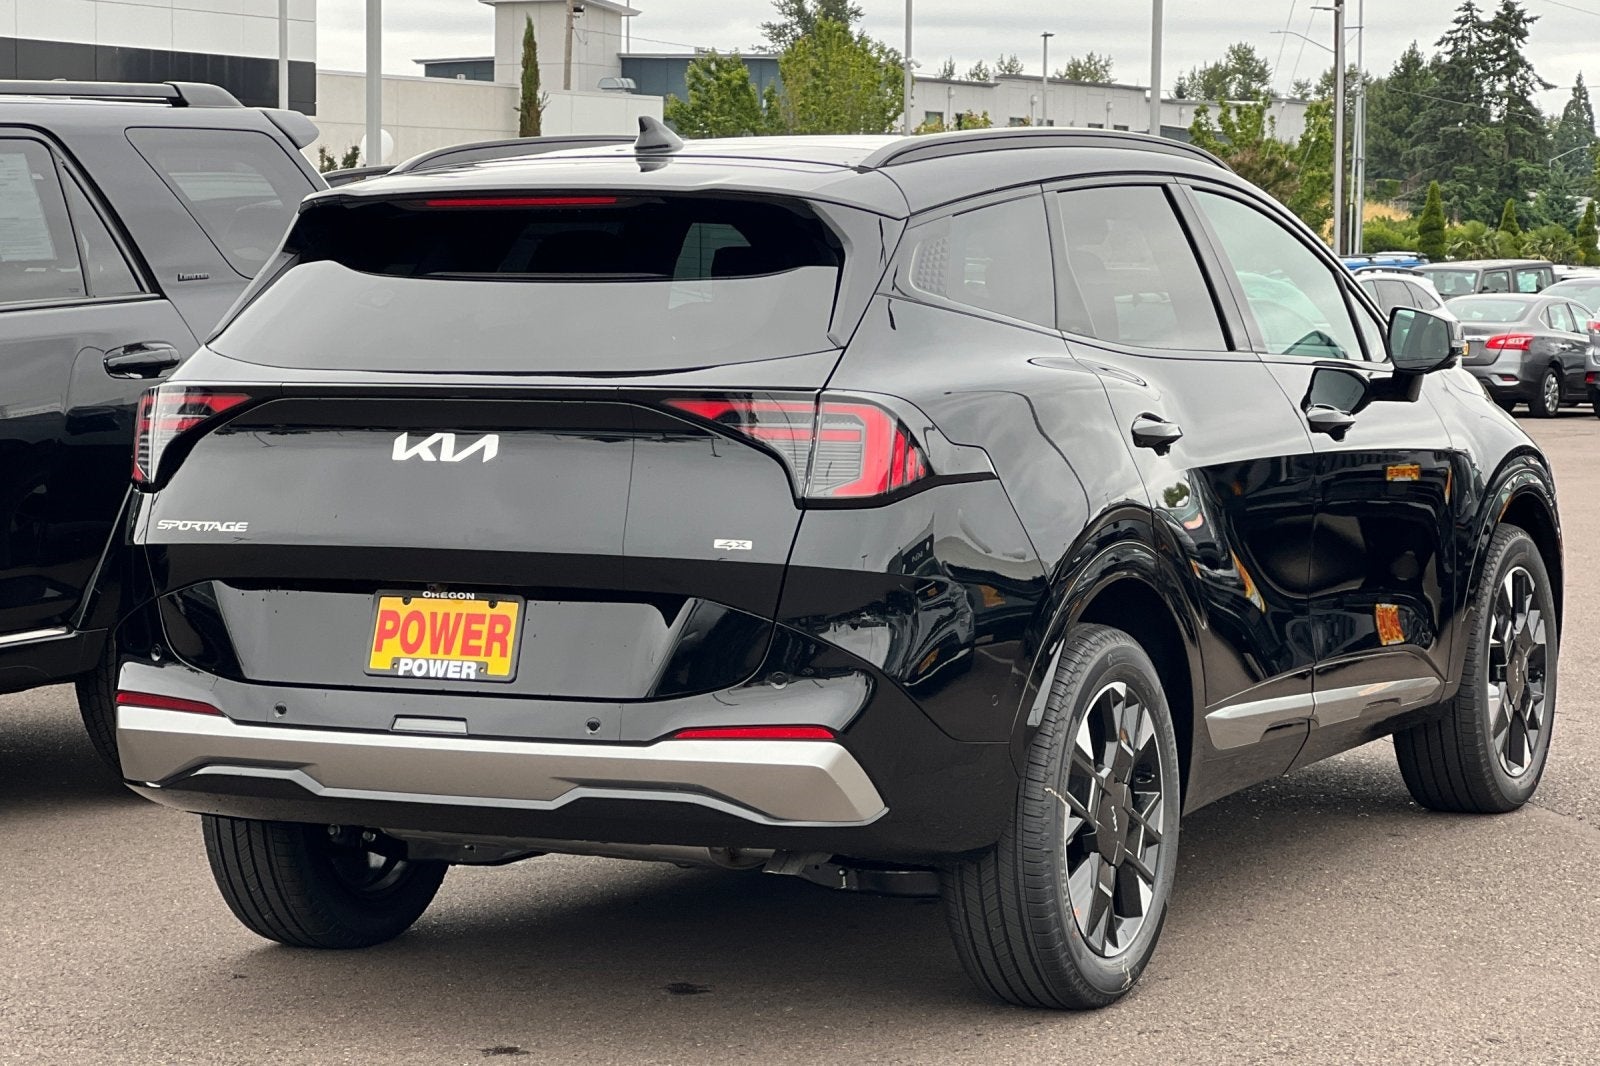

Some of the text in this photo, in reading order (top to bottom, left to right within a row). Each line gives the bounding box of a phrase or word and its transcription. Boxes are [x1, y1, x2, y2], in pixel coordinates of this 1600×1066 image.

[392, 432, 499, 463] KIA
[157, 520, 249, 532] SPORTAGE
[422, 591, 475, 600] OREGON
[374, 609, 512, 658] POWER
[397, 658, 477, 679] POWER
